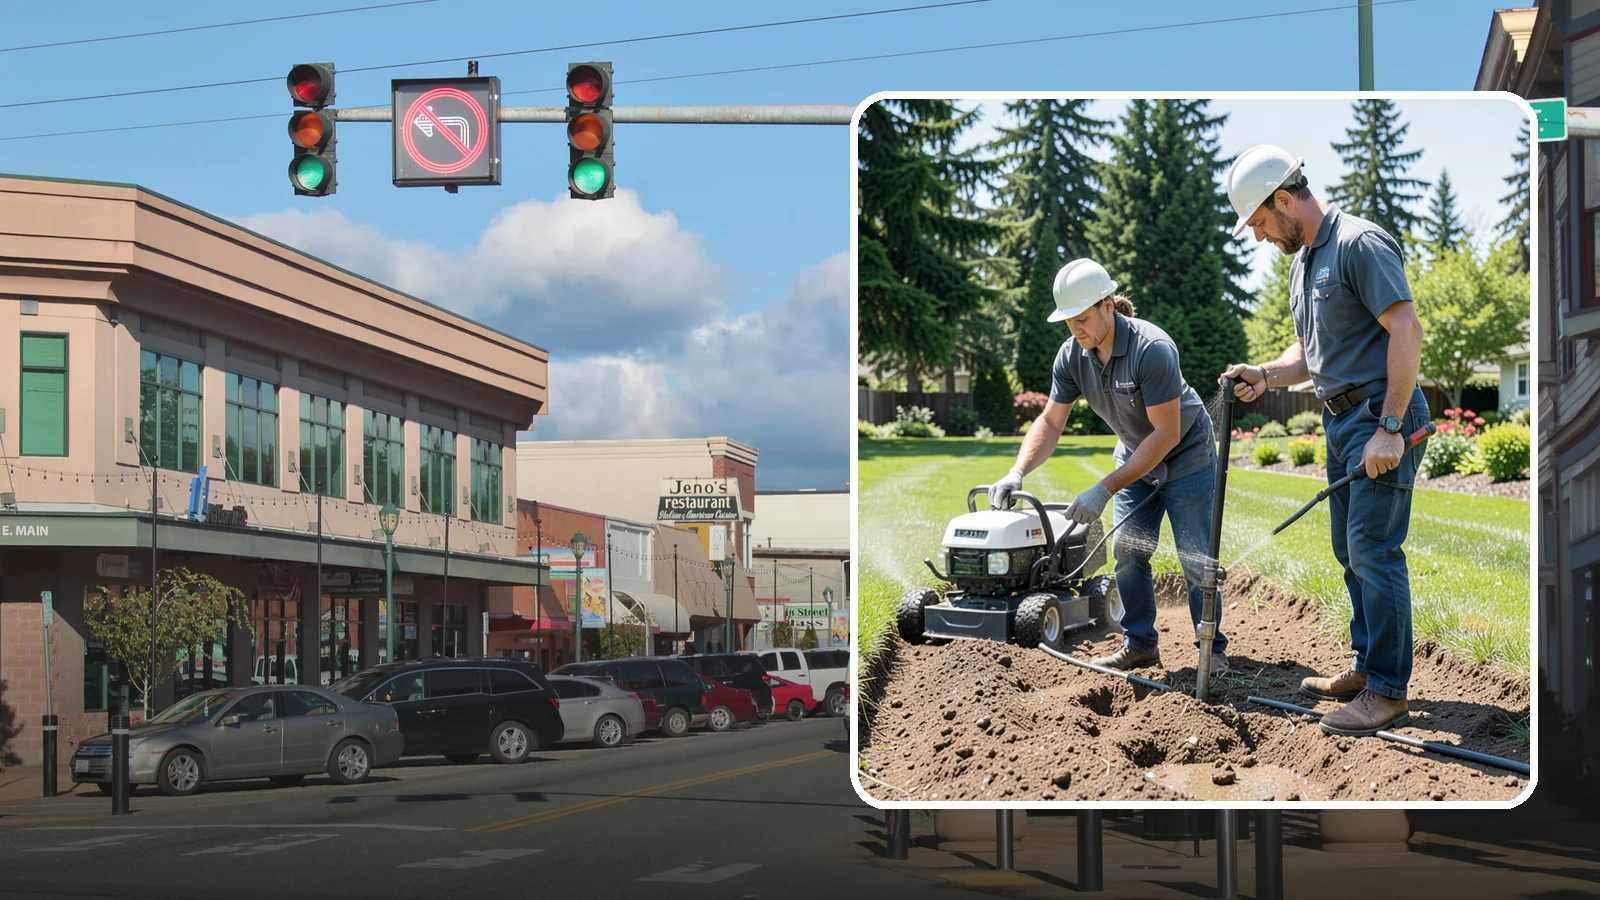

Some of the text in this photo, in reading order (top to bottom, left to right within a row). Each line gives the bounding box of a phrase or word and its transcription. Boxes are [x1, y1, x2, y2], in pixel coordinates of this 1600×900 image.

[670, 480, 727, 494] Jeno's
[665, 496, 731, 509] restaurant
[659, 510, 681, 519] Italian
[686, 510, 714, 519] American
[715, 510, 738, 519] Cuisine
[2, 525, 49, 536] E. MAIN
[798, 608, 828, 616] Street
